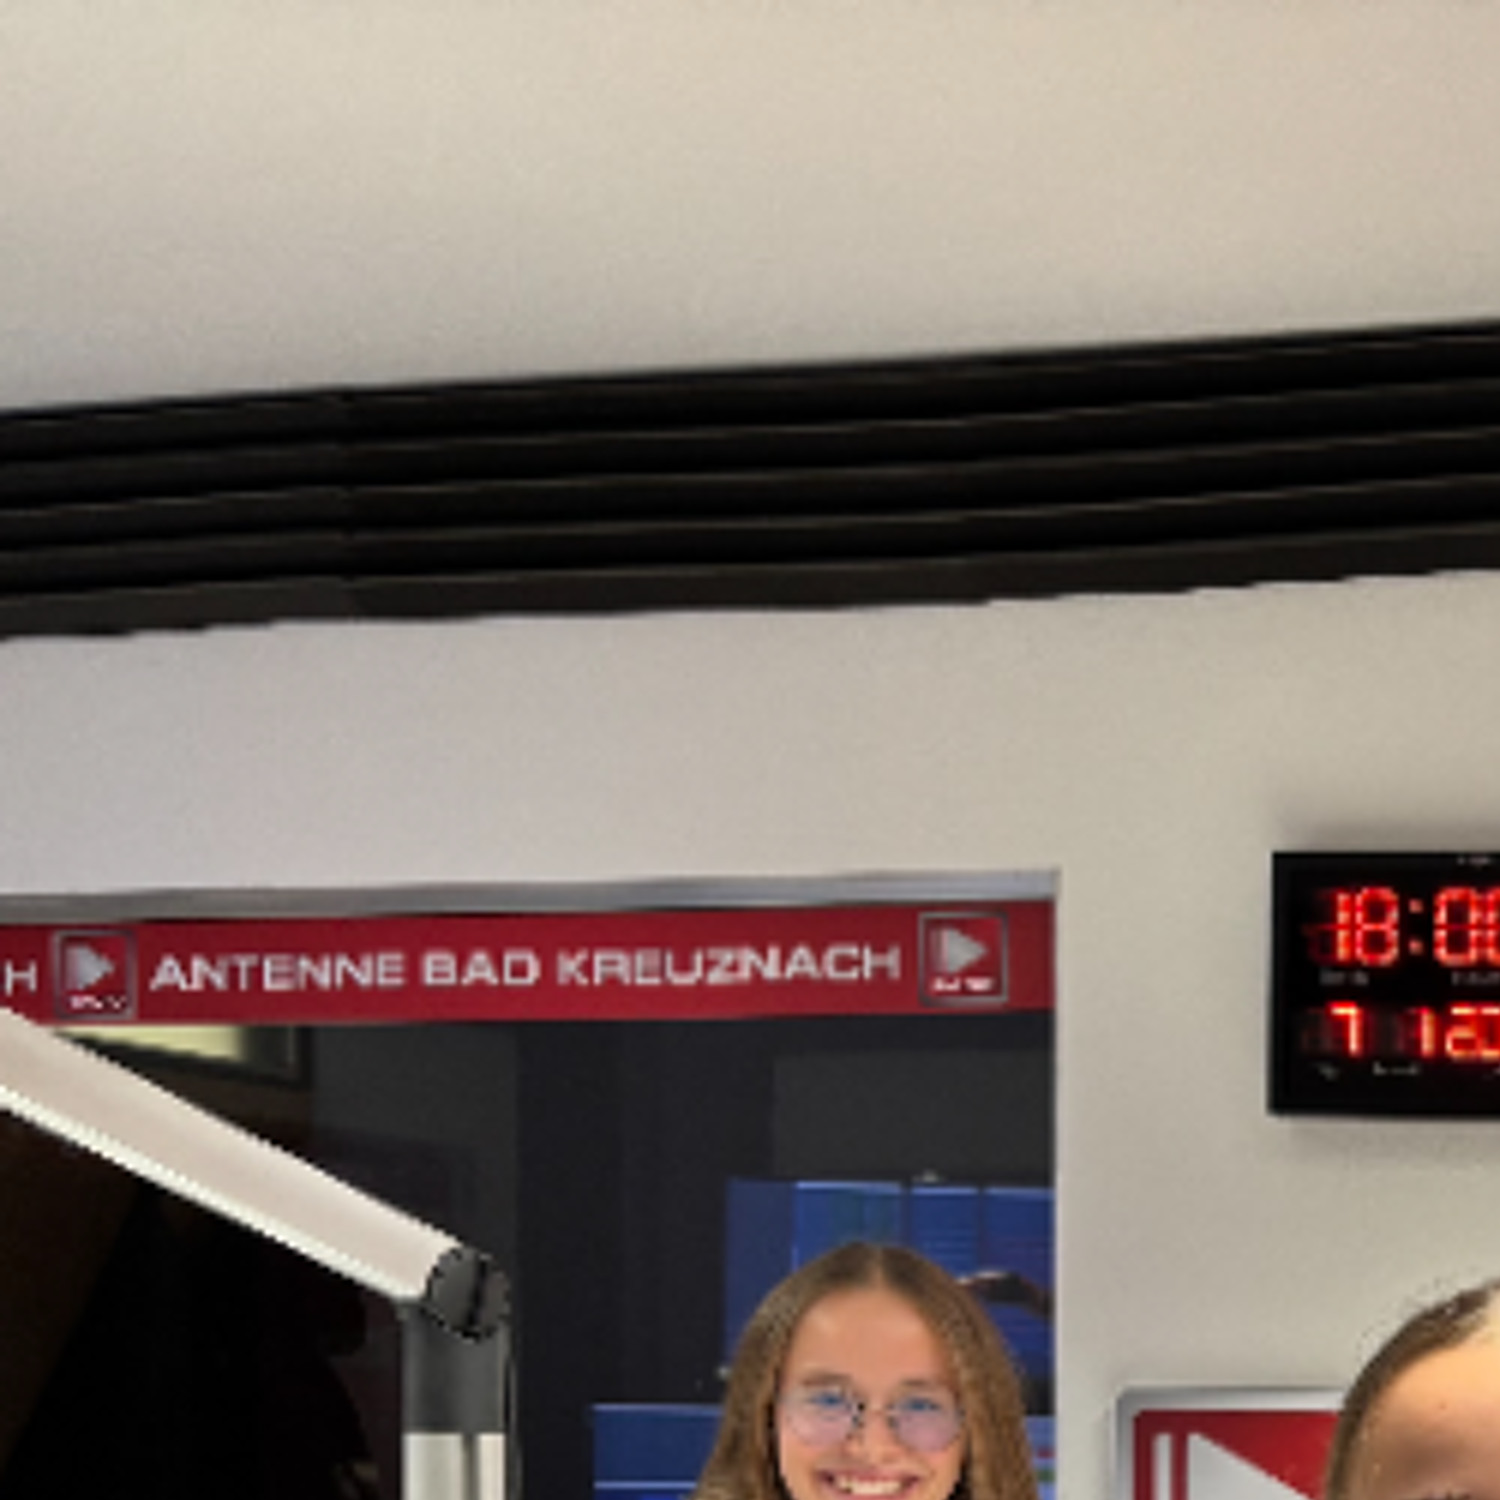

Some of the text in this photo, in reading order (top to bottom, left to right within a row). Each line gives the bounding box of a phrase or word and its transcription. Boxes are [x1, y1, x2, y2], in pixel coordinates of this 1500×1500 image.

[149, 943, 902, 993] ANTENNE BAD KREUZNACH
